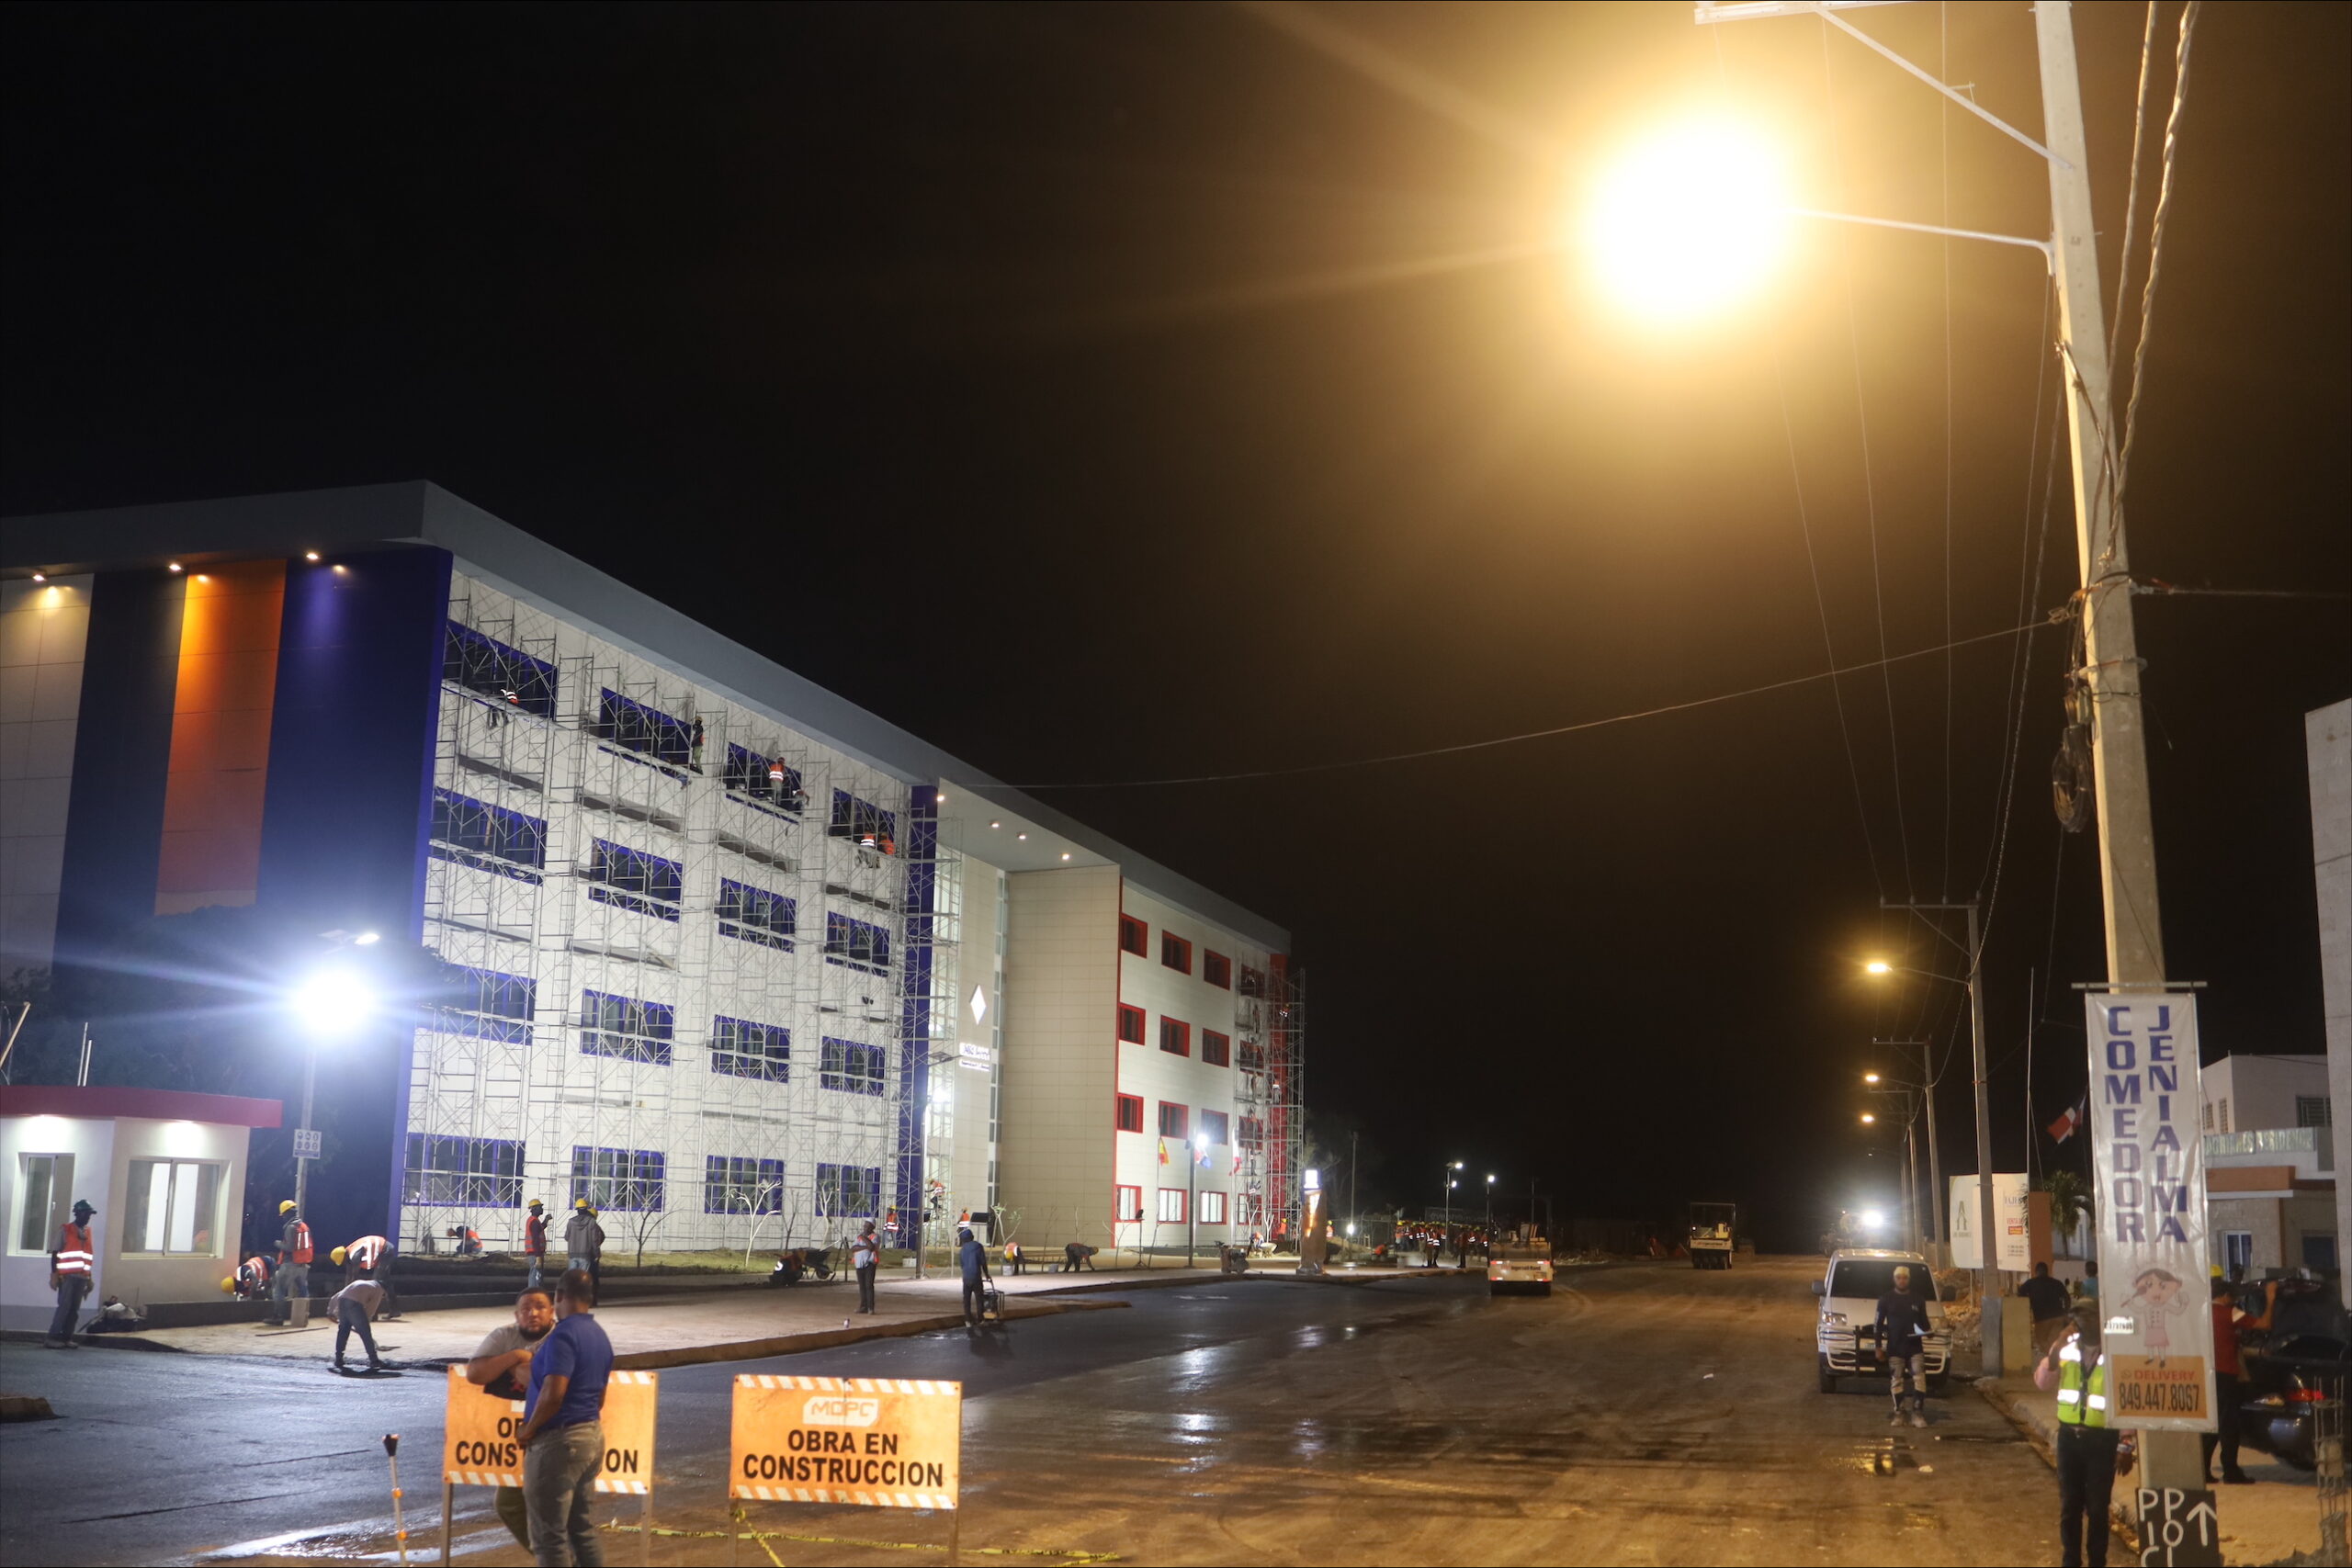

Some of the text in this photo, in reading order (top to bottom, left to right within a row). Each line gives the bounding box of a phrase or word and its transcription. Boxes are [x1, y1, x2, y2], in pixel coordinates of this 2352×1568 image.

[2104, 1006, 2146, 1243] COMEDOR
[2147, 1005, 2188, 1243] JENIALMA
[2133, 1370, 2195, 1382] DELIVERY
[2119, 1382, 2199, 1412] 849.447.8067
[787, 1429, 898, 1455] OBRA EN
[743, 1454, 944, 1487] CONSTRUCCION
